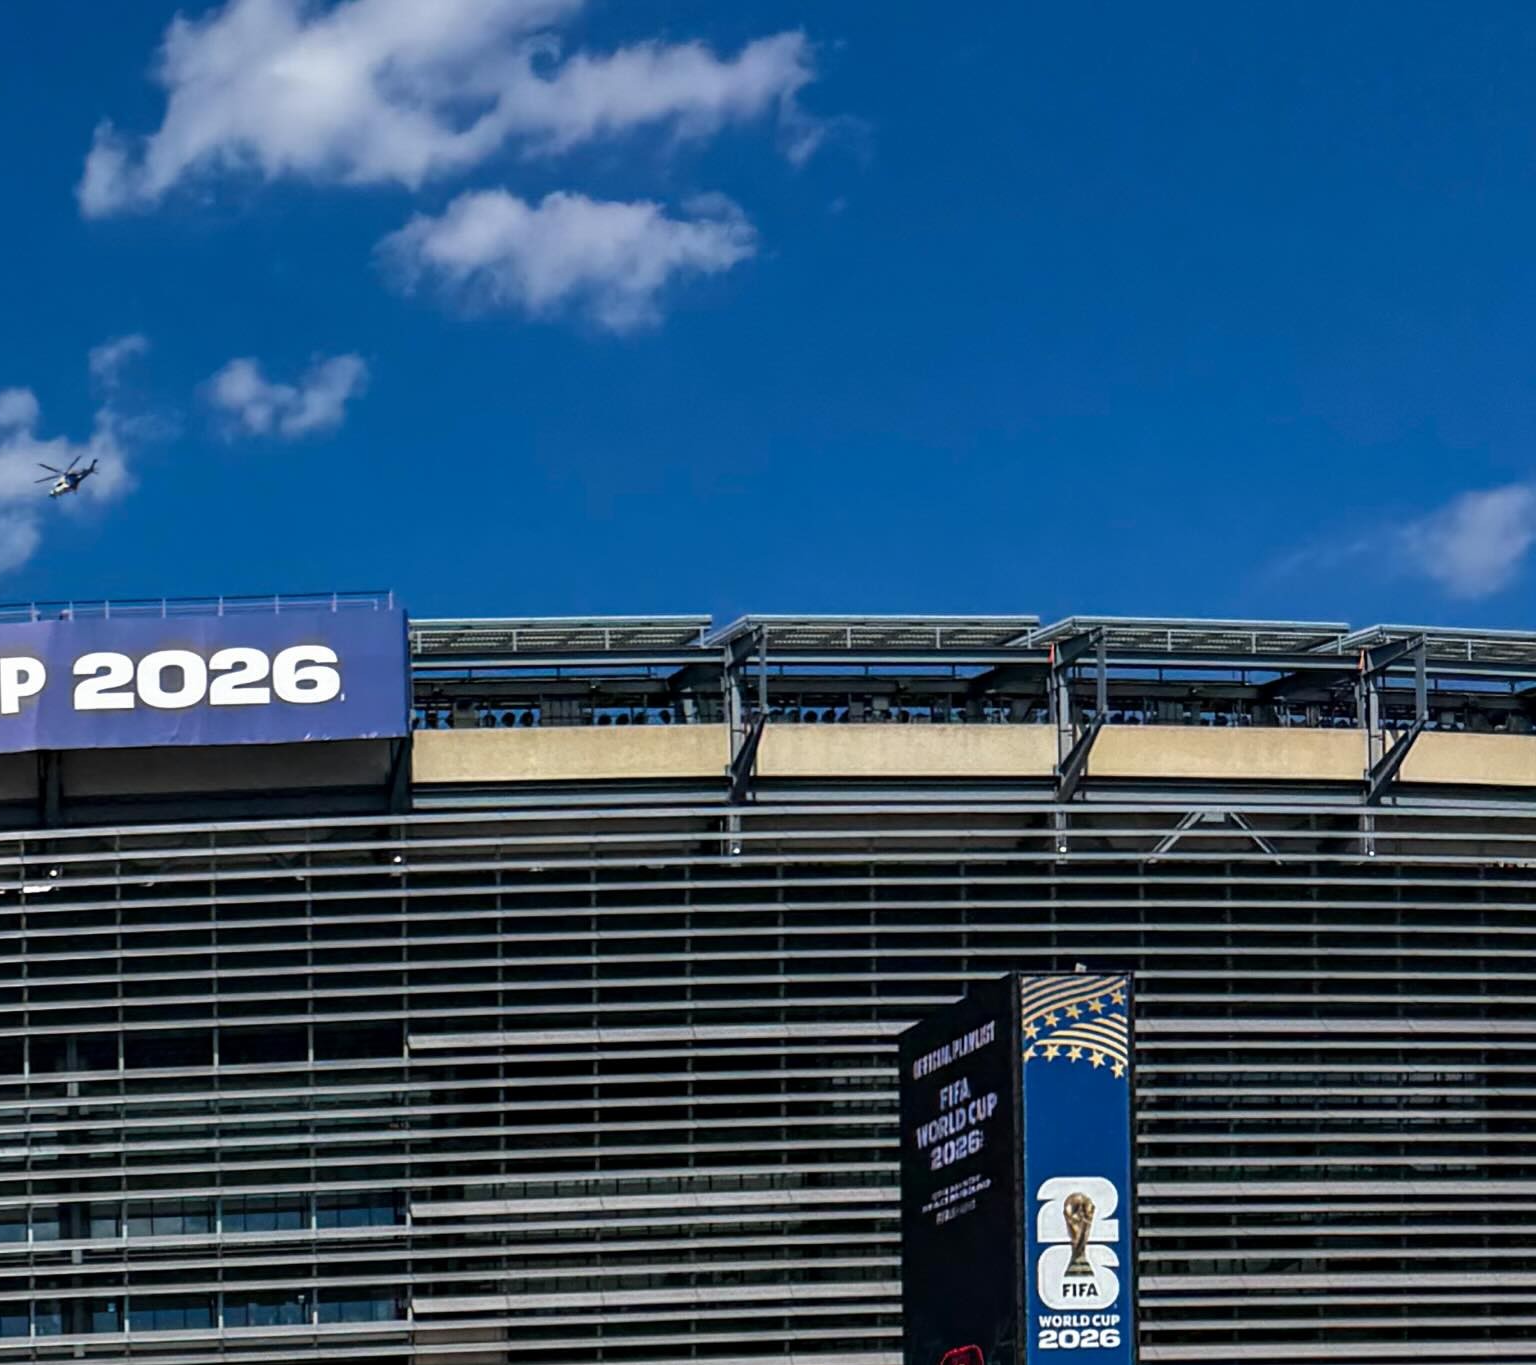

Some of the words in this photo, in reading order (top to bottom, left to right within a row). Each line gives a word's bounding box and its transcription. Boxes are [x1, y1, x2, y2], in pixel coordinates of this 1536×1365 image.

[73, 645, 341, 711] 2026
[940, 1077, 971, 1110] FIFA
[917, 1108, 966, 1149] WORLD
[968, 1092, 997, 1125] CUP
[931, 1129, 980, 1170] 2026
[1063, 1283, 1099, 1298] FIFA
[1038, 1315, 1091, 1328] WORLD
[1092, 1314, 1121, 1328] CUP
[1038, 1329, 1121, 1349] 2026
